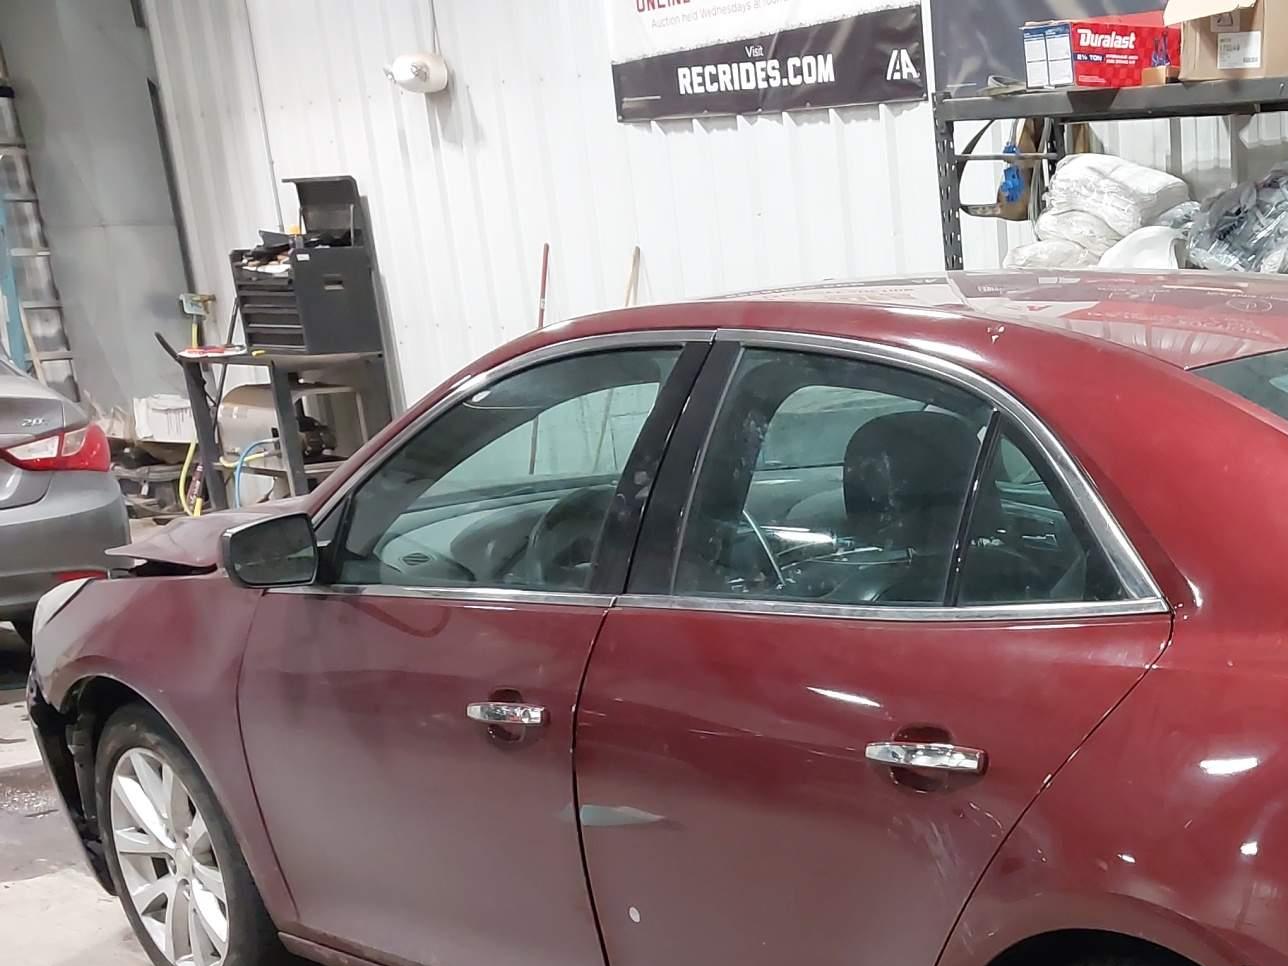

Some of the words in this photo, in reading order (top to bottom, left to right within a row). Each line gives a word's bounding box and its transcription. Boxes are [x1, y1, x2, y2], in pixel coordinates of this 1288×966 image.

[1077, 28, 1136, 49] Duralast
[745, 45, 764, 58] Visit
[677, 53, 835, 95] RECRIDES.COM
